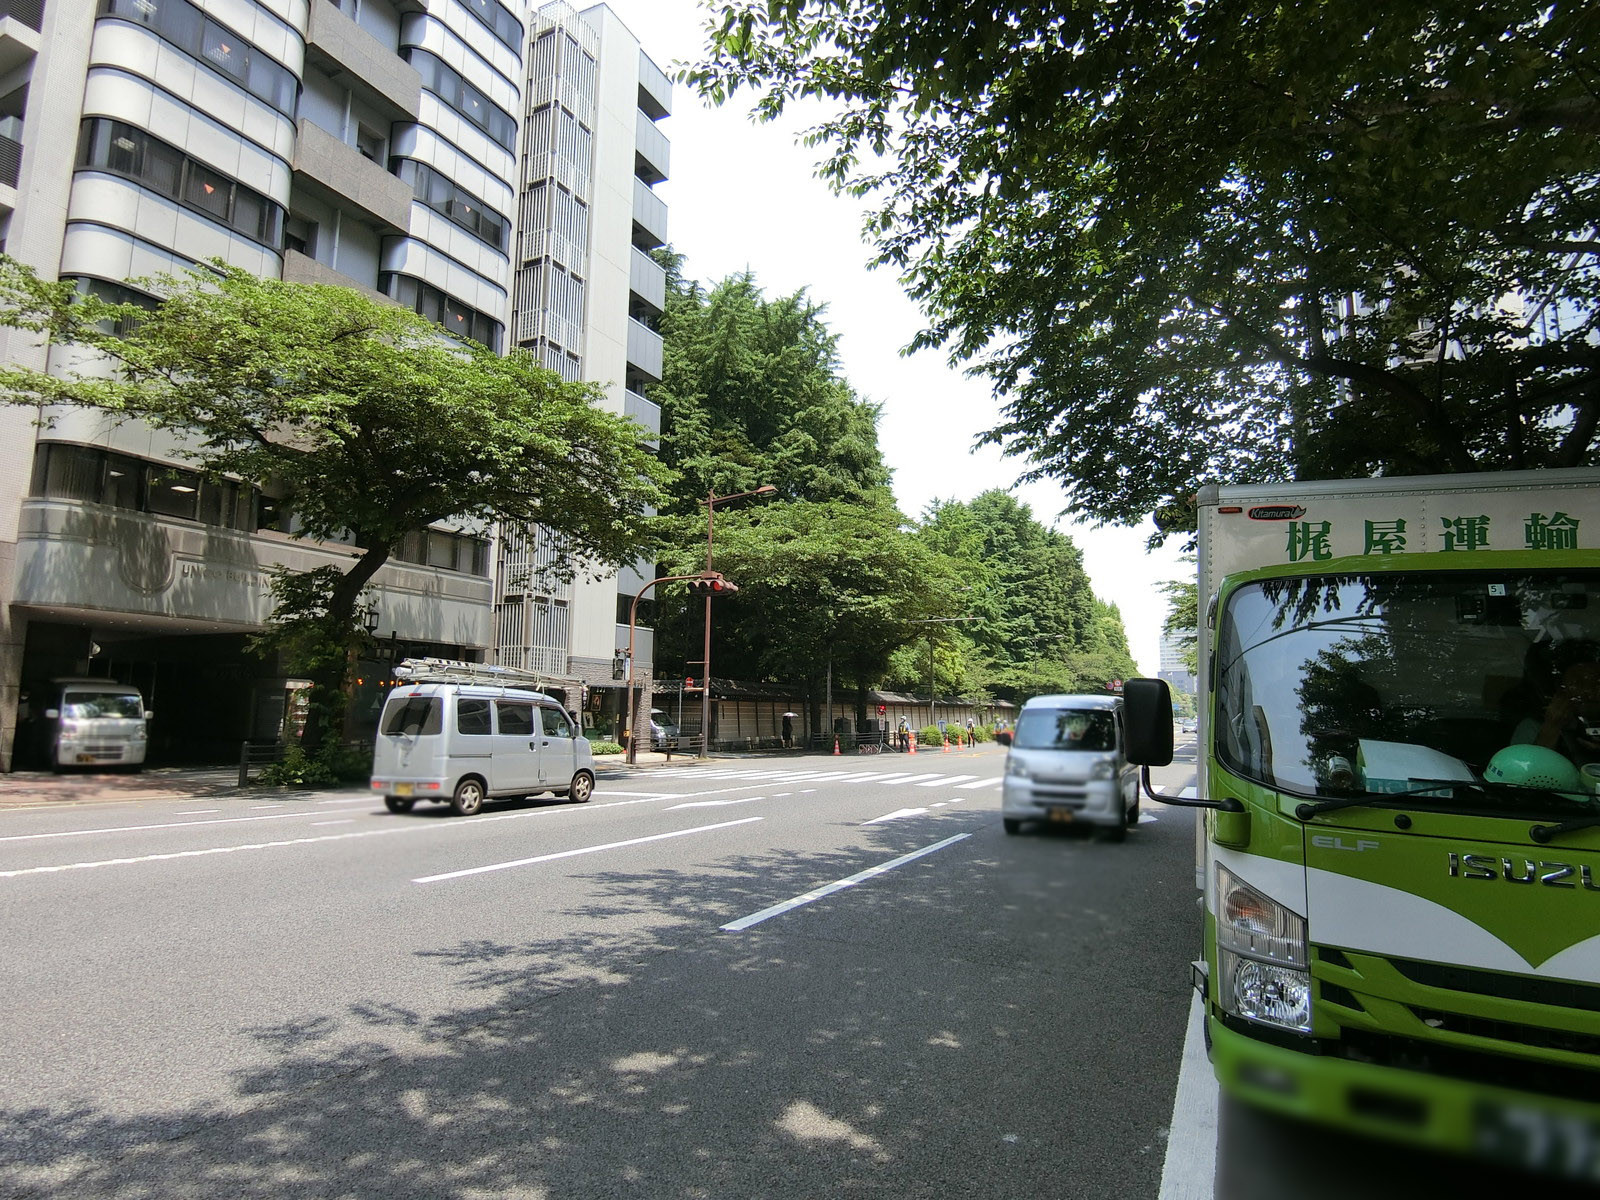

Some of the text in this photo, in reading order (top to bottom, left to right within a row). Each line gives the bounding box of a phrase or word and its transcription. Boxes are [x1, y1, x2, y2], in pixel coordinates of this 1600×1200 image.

[1250, 508, 1291, 518] Kitamura
[1285, 511, 1581, 562] 梶屋運輸
[1311, 835, 1380, 851] ELF
